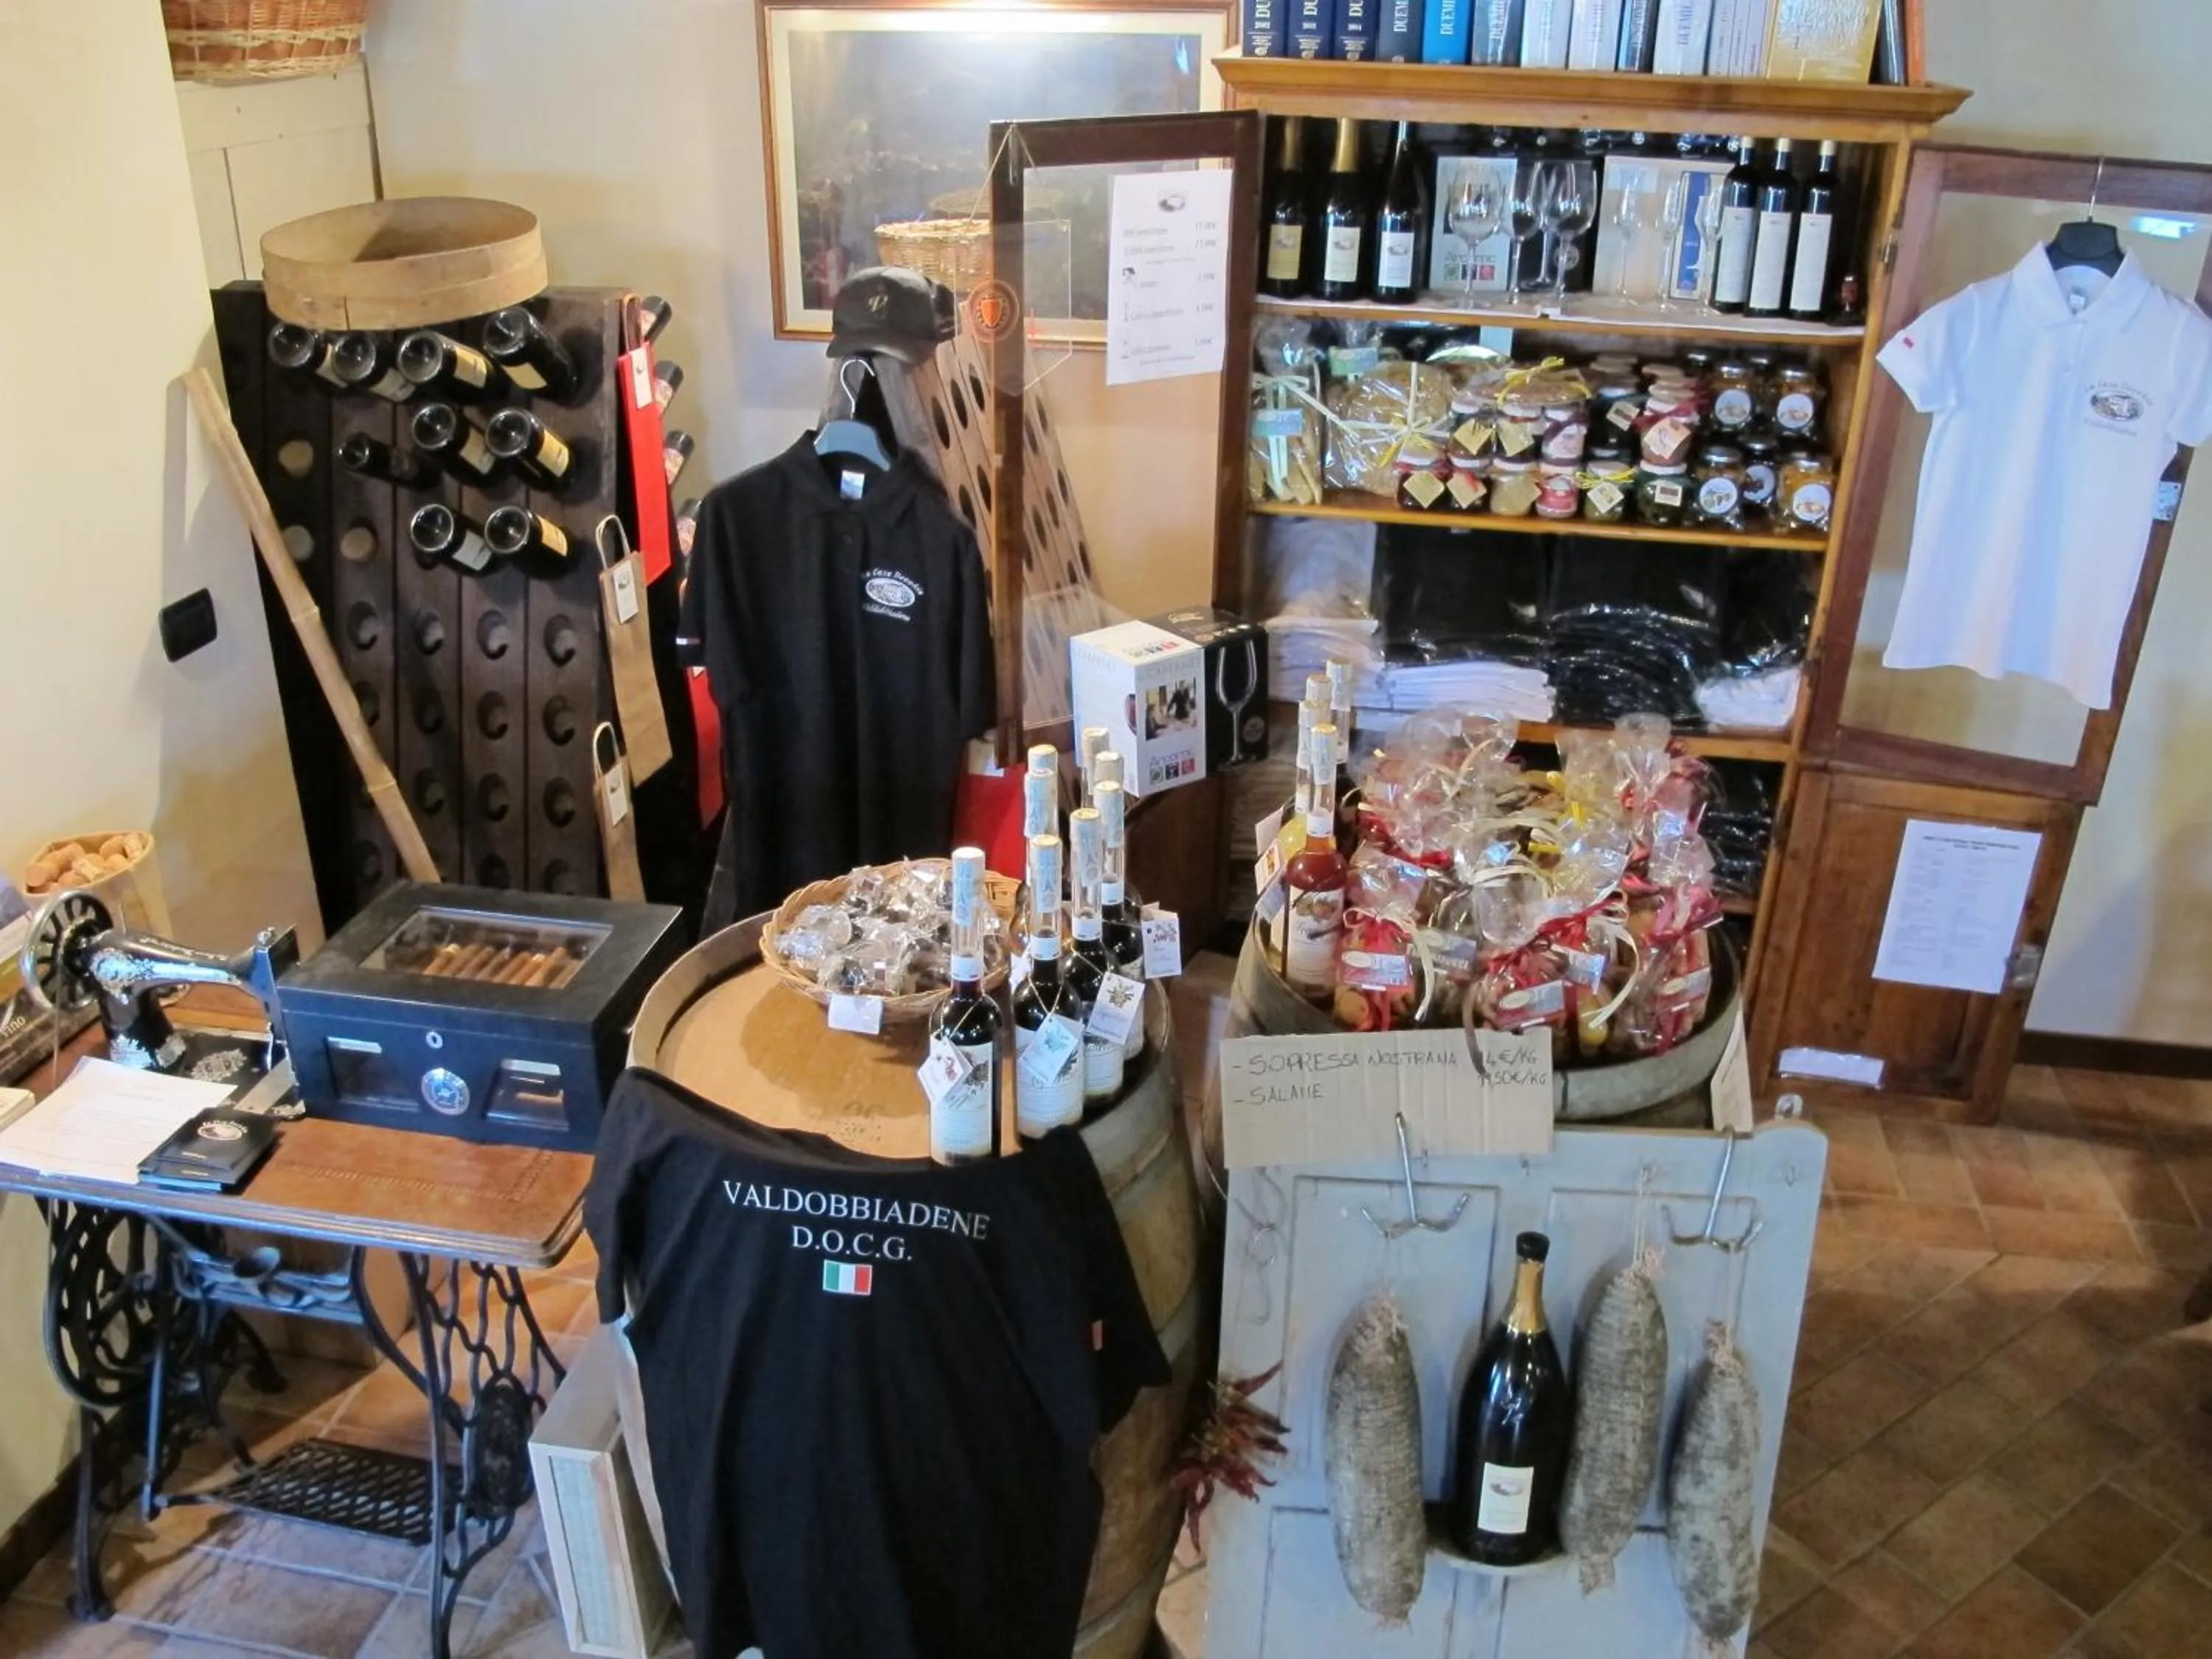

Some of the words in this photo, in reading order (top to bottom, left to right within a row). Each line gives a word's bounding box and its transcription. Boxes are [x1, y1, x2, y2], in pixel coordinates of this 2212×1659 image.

[1248, 1050, 1360, 1075] SOPRESSA
[1249, 1082, 1325, 1105] SALAME
[722, 1180, 991, 1240] VALDOBBIADENE
[792, 1225, 913, 1262] D.O.C.G.
